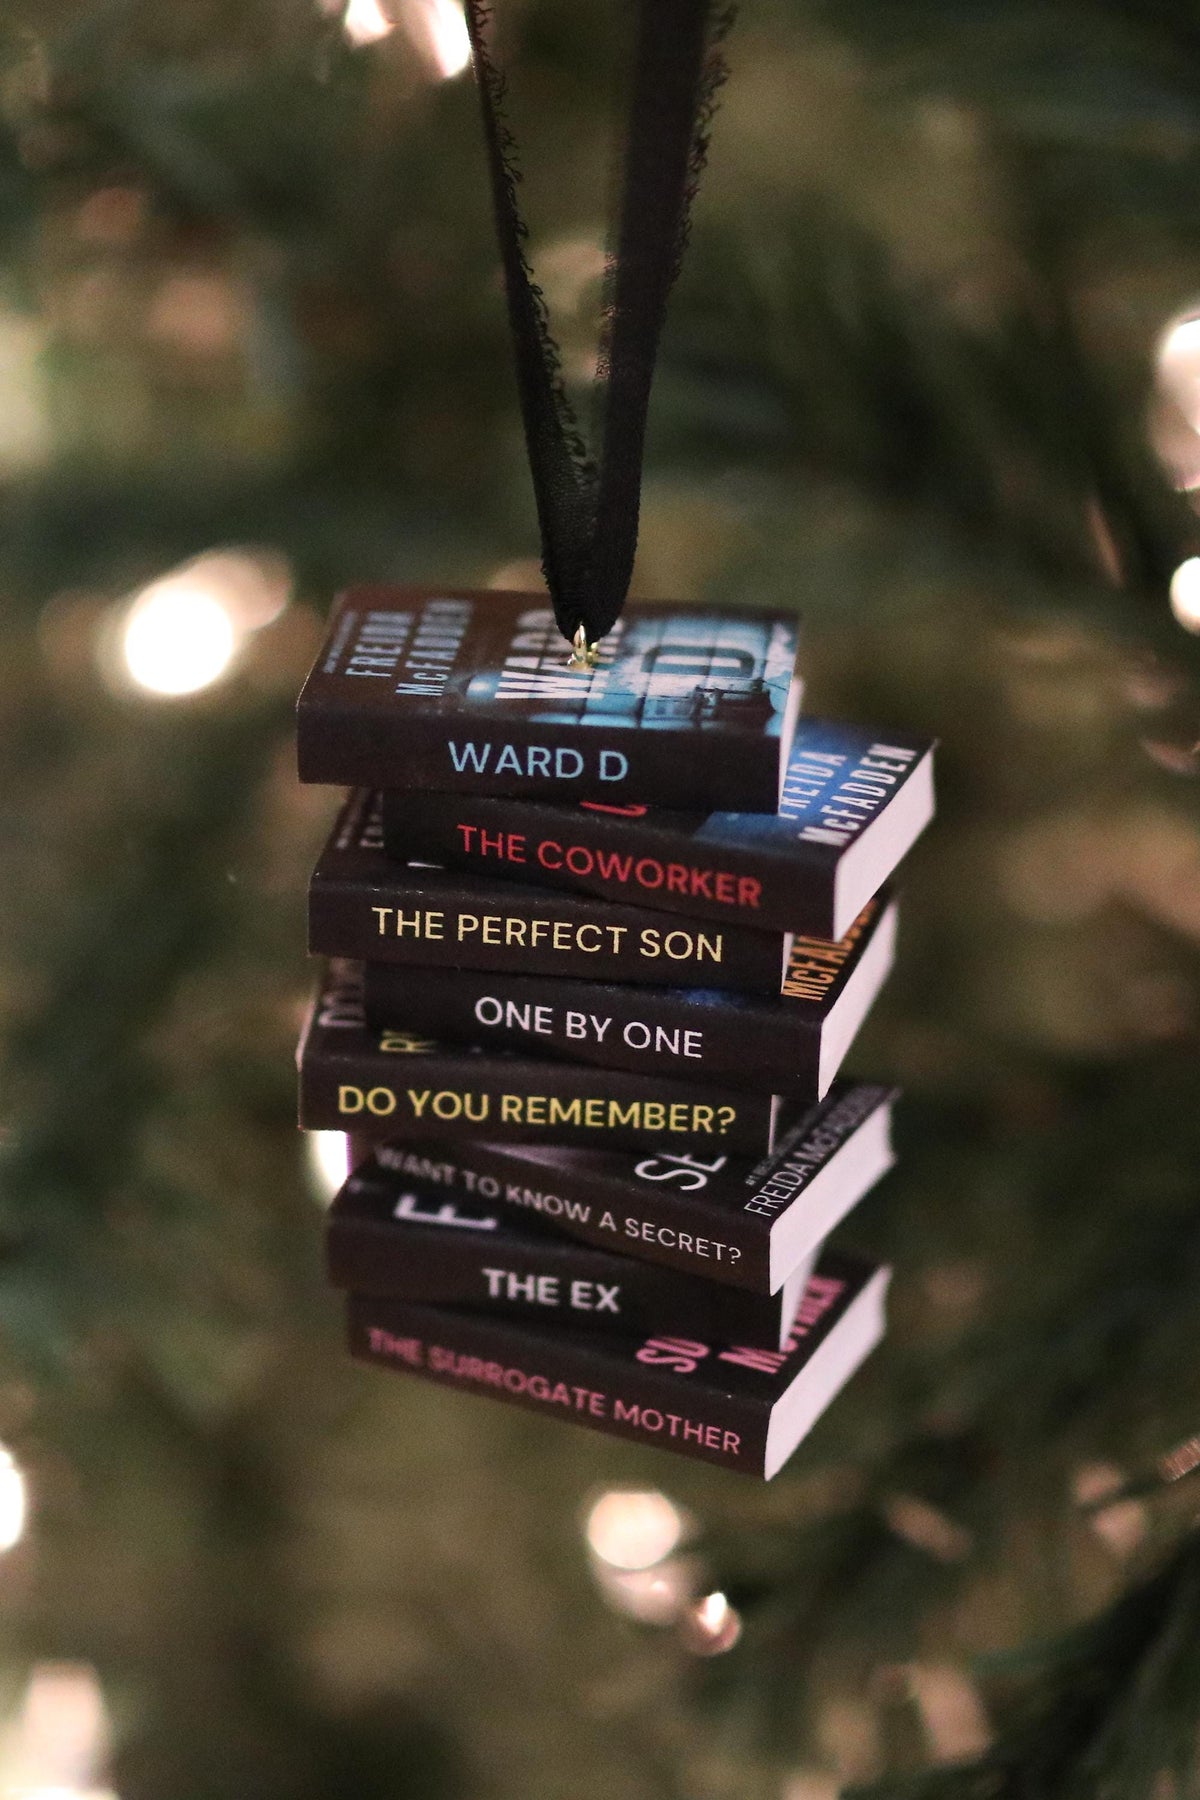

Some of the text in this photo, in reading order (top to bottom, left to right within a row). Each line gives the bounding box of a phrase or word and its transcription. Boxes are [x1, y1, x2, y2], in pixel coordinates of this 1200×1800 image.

[448, 741, 629, 782] WARD D
[457, 823, 763, 907] THE COWORKER
[372, 906, 723, 963] THE PERFECT SON
[474, 996, 703, 1058] ONE BY ONE
[338, 1085, 736, 1134] DO YOU REMEMBER?
[373, 1146, 742, 1265] WANT TO KNOW A SECRET?
[743, 1161, 816, 1218] FREIDA
[481, 1268, 621, 1314] THE EX
[367, 1327, 741, 1455] THE SURROGATE MOTHER
